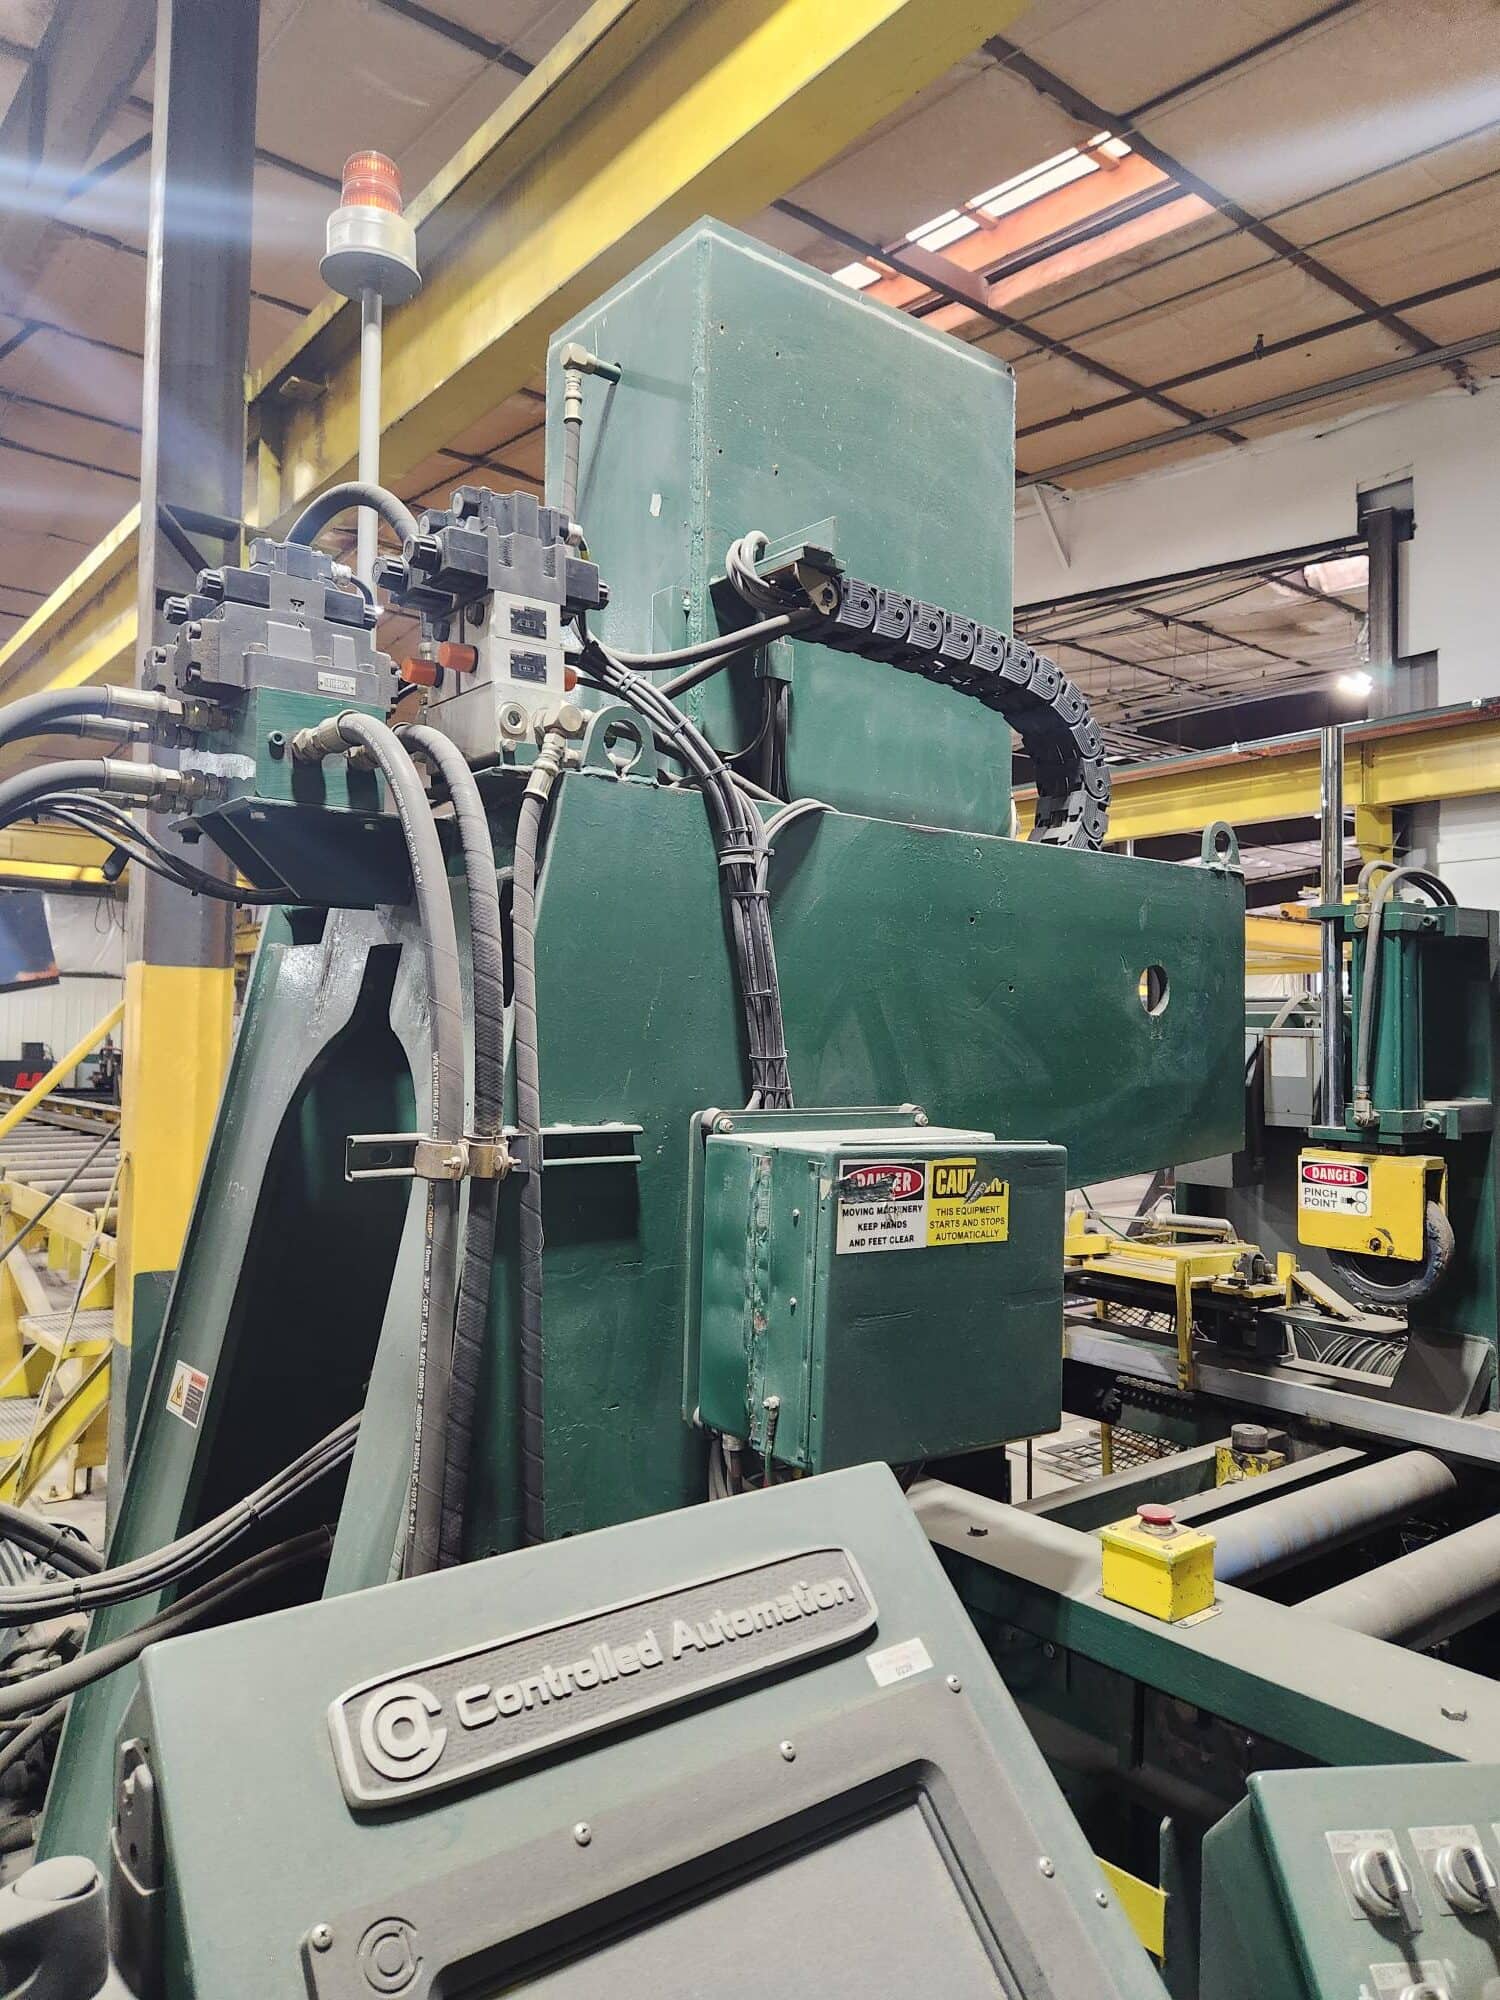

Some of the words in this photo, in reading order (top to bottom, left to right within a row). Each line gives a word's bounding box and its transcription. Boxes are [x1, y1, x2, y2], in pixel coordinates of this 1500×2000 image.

[431, 1051, 440, 1121] WEATHERHEAD
[1311, 1167, 1357, 1183] DANGER
[1304, 1187, 1338, 1198] PINCH
[1304, 1197, 1337, 1208] POINT
[842, 1207, 874, 1217] MOVING
[876, 1204, 923, 1216] MACHINERY
[936, 1208, 954, 1217] THIS
[956, 1205, 1001, 1216] EQUIPMENT
[857, 1221, 878, 1232] KEEP
[880, 1219, 908, 1230] HANDS
[929, 1219, 960, 1229] STARTS
[963, 1218, 979, 1228] AND
[980, 1217, 1005, 1227] STOPS
[849, 1238, 866, 1248] AND
[868, 1236, 887, 1246] FEET
[890, 1235, 915, 1245] CLEAR
[935, 1230, 1000, 1242] AUTOMATICALLY
[420, 1322, 428, 1341] USA
[456, 1629, 663, 1730] Controlled
[672, 1578, 855, 1660] Automation
